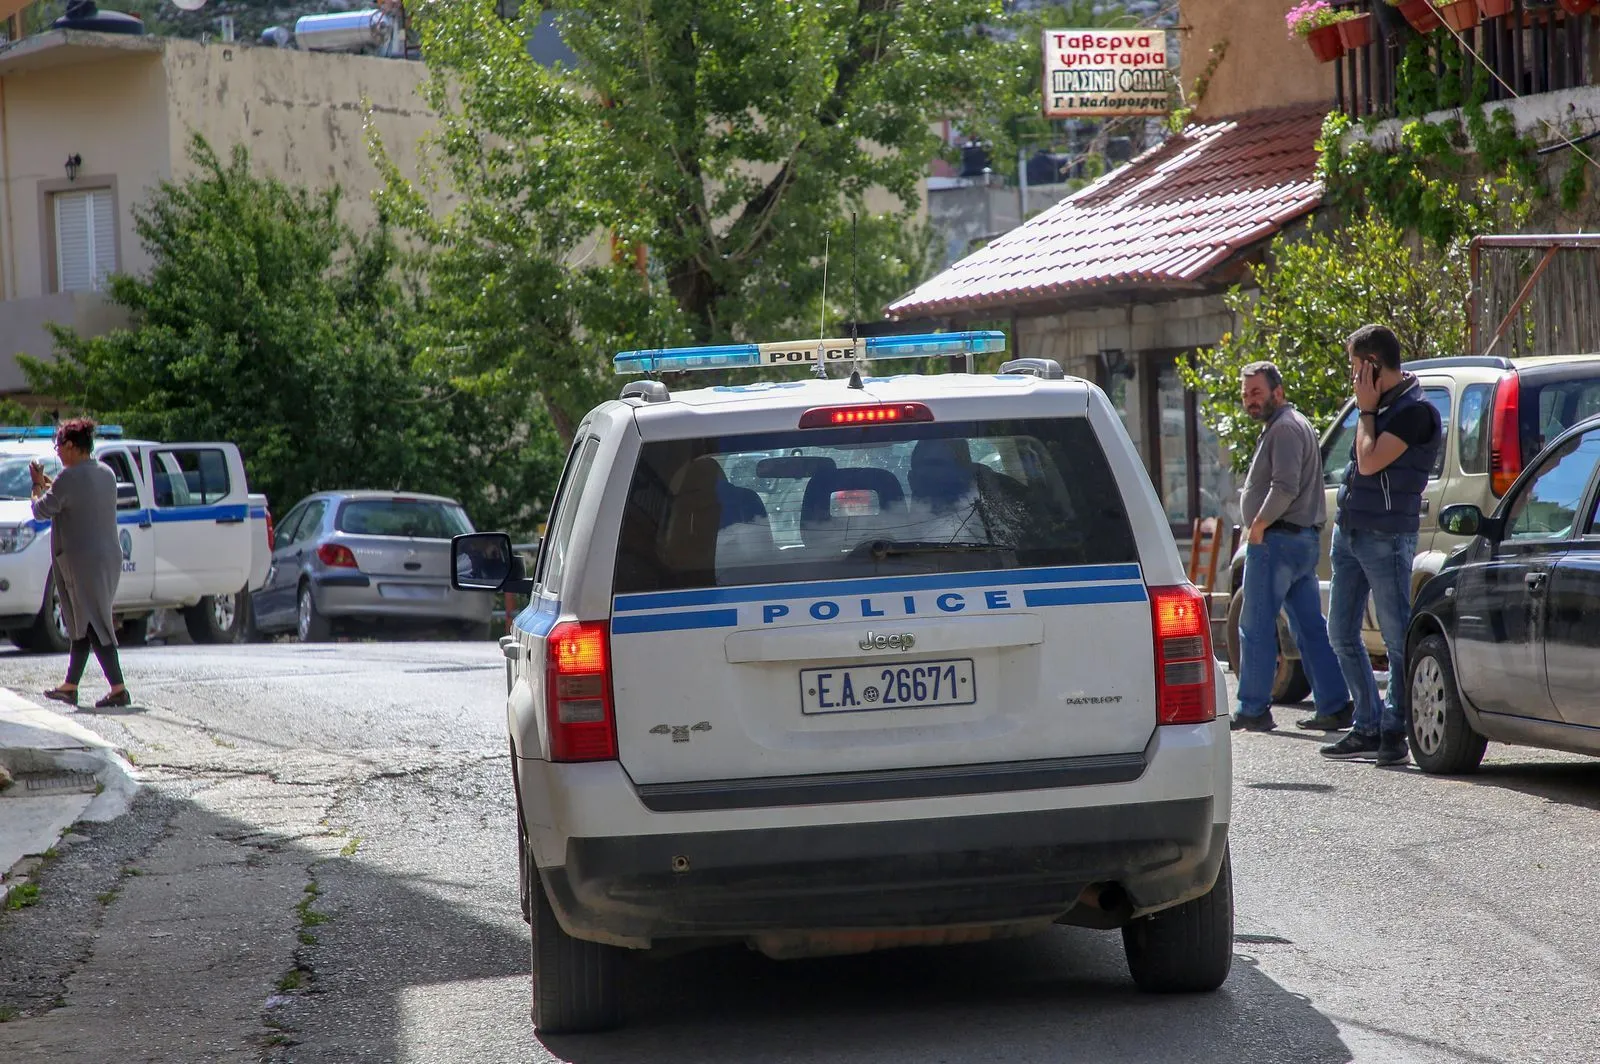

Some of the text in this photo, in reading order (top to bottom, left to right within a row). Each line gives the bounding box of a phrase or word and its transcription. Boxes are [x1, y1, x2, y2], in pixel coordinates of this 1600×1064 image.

[1053, 34, 1150, 50] Ταβερνα
[1052, 69, 1115, 93] ΠΡΑΣΙΝΗ
[769, 348, 856, 362] POLCE
[763, 590, 1011, 624] POLICE
[858, 630, 917, 652] Jeep
[881, 664, 958, 704] 26671
